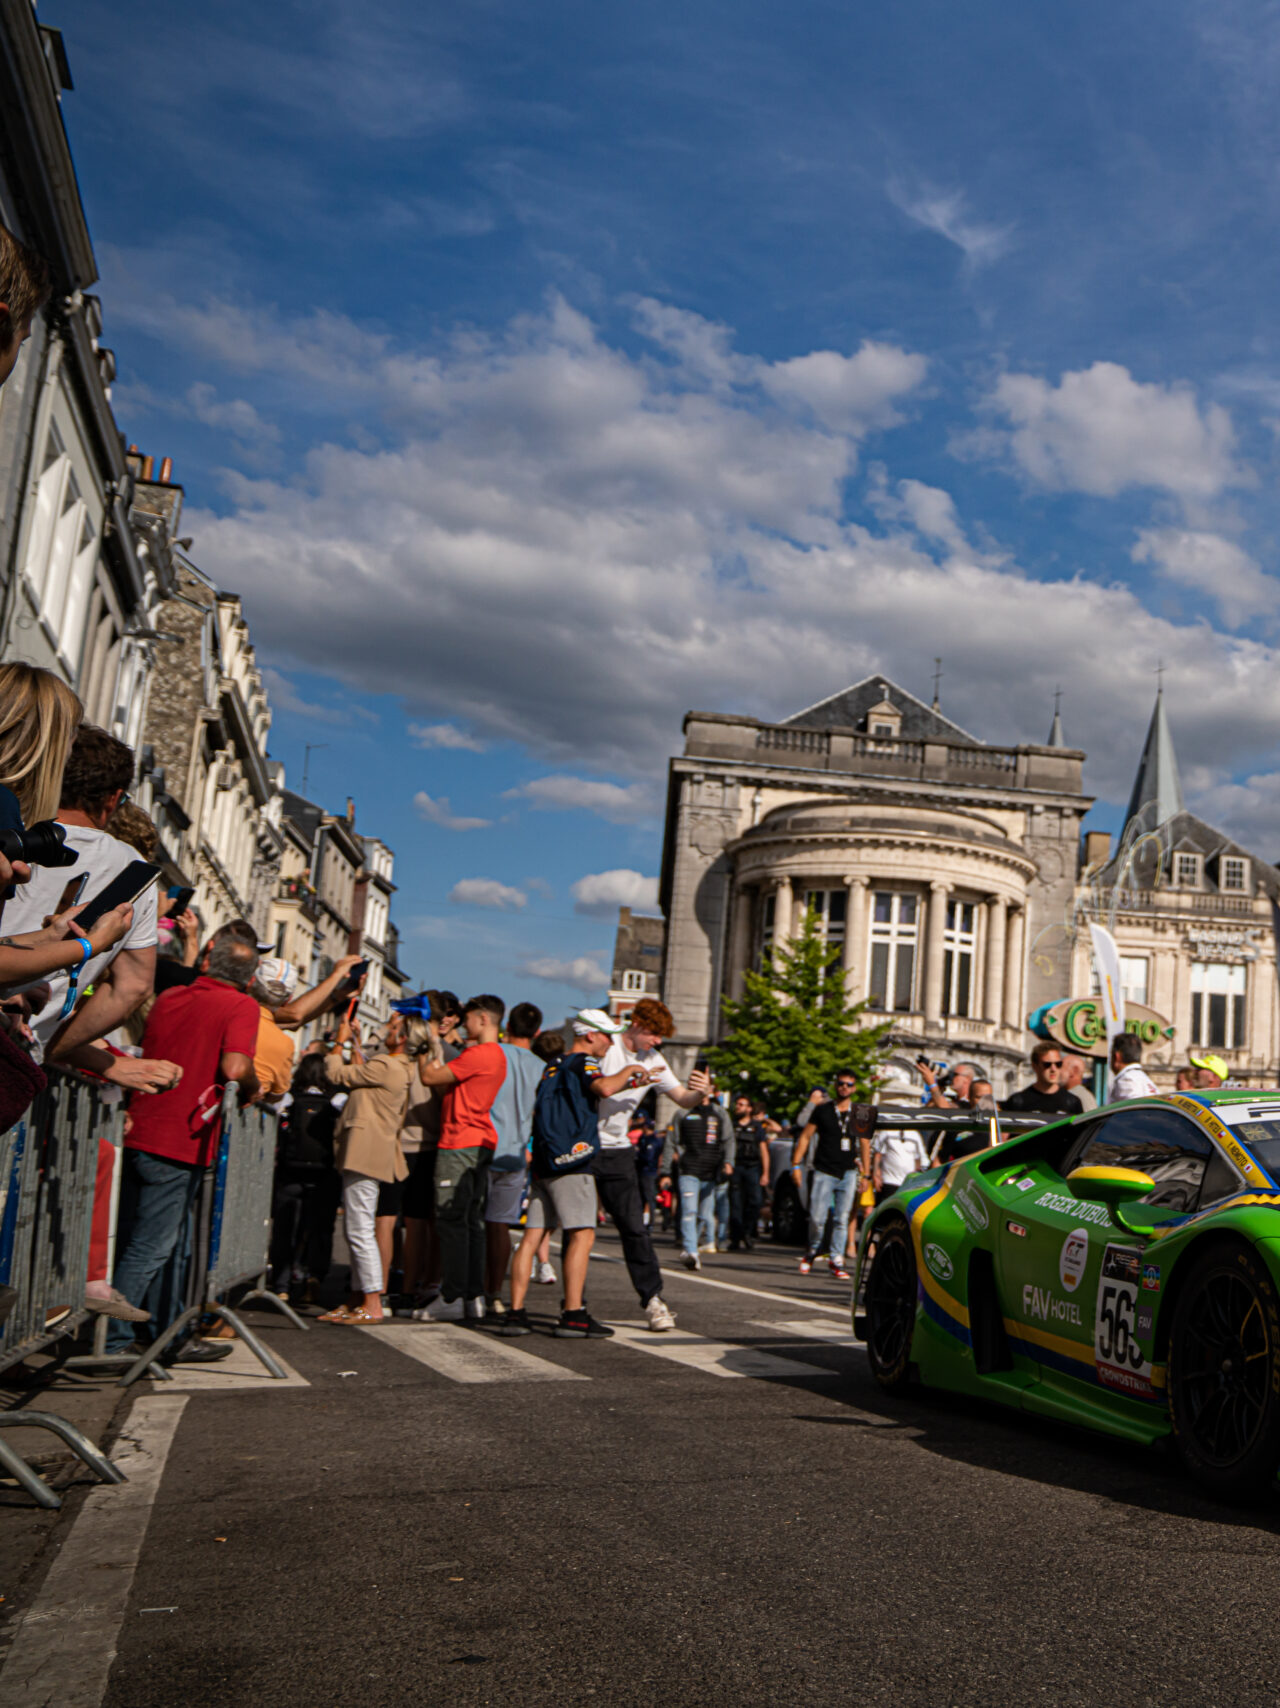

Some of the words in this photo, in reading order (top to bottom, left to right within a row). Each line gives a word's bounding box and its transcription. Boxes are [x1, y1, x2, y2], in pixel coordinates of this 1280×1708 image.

[1066, 1001, 1161, 1048] Casno
[1034, 1192, 1078, 1214] ROGER
[1023, 1284, 1052, 1320] FAV
[1051, 1297, 1082, 1326] HOTEL
[1137, 1315, 1152, 1329] FAV
